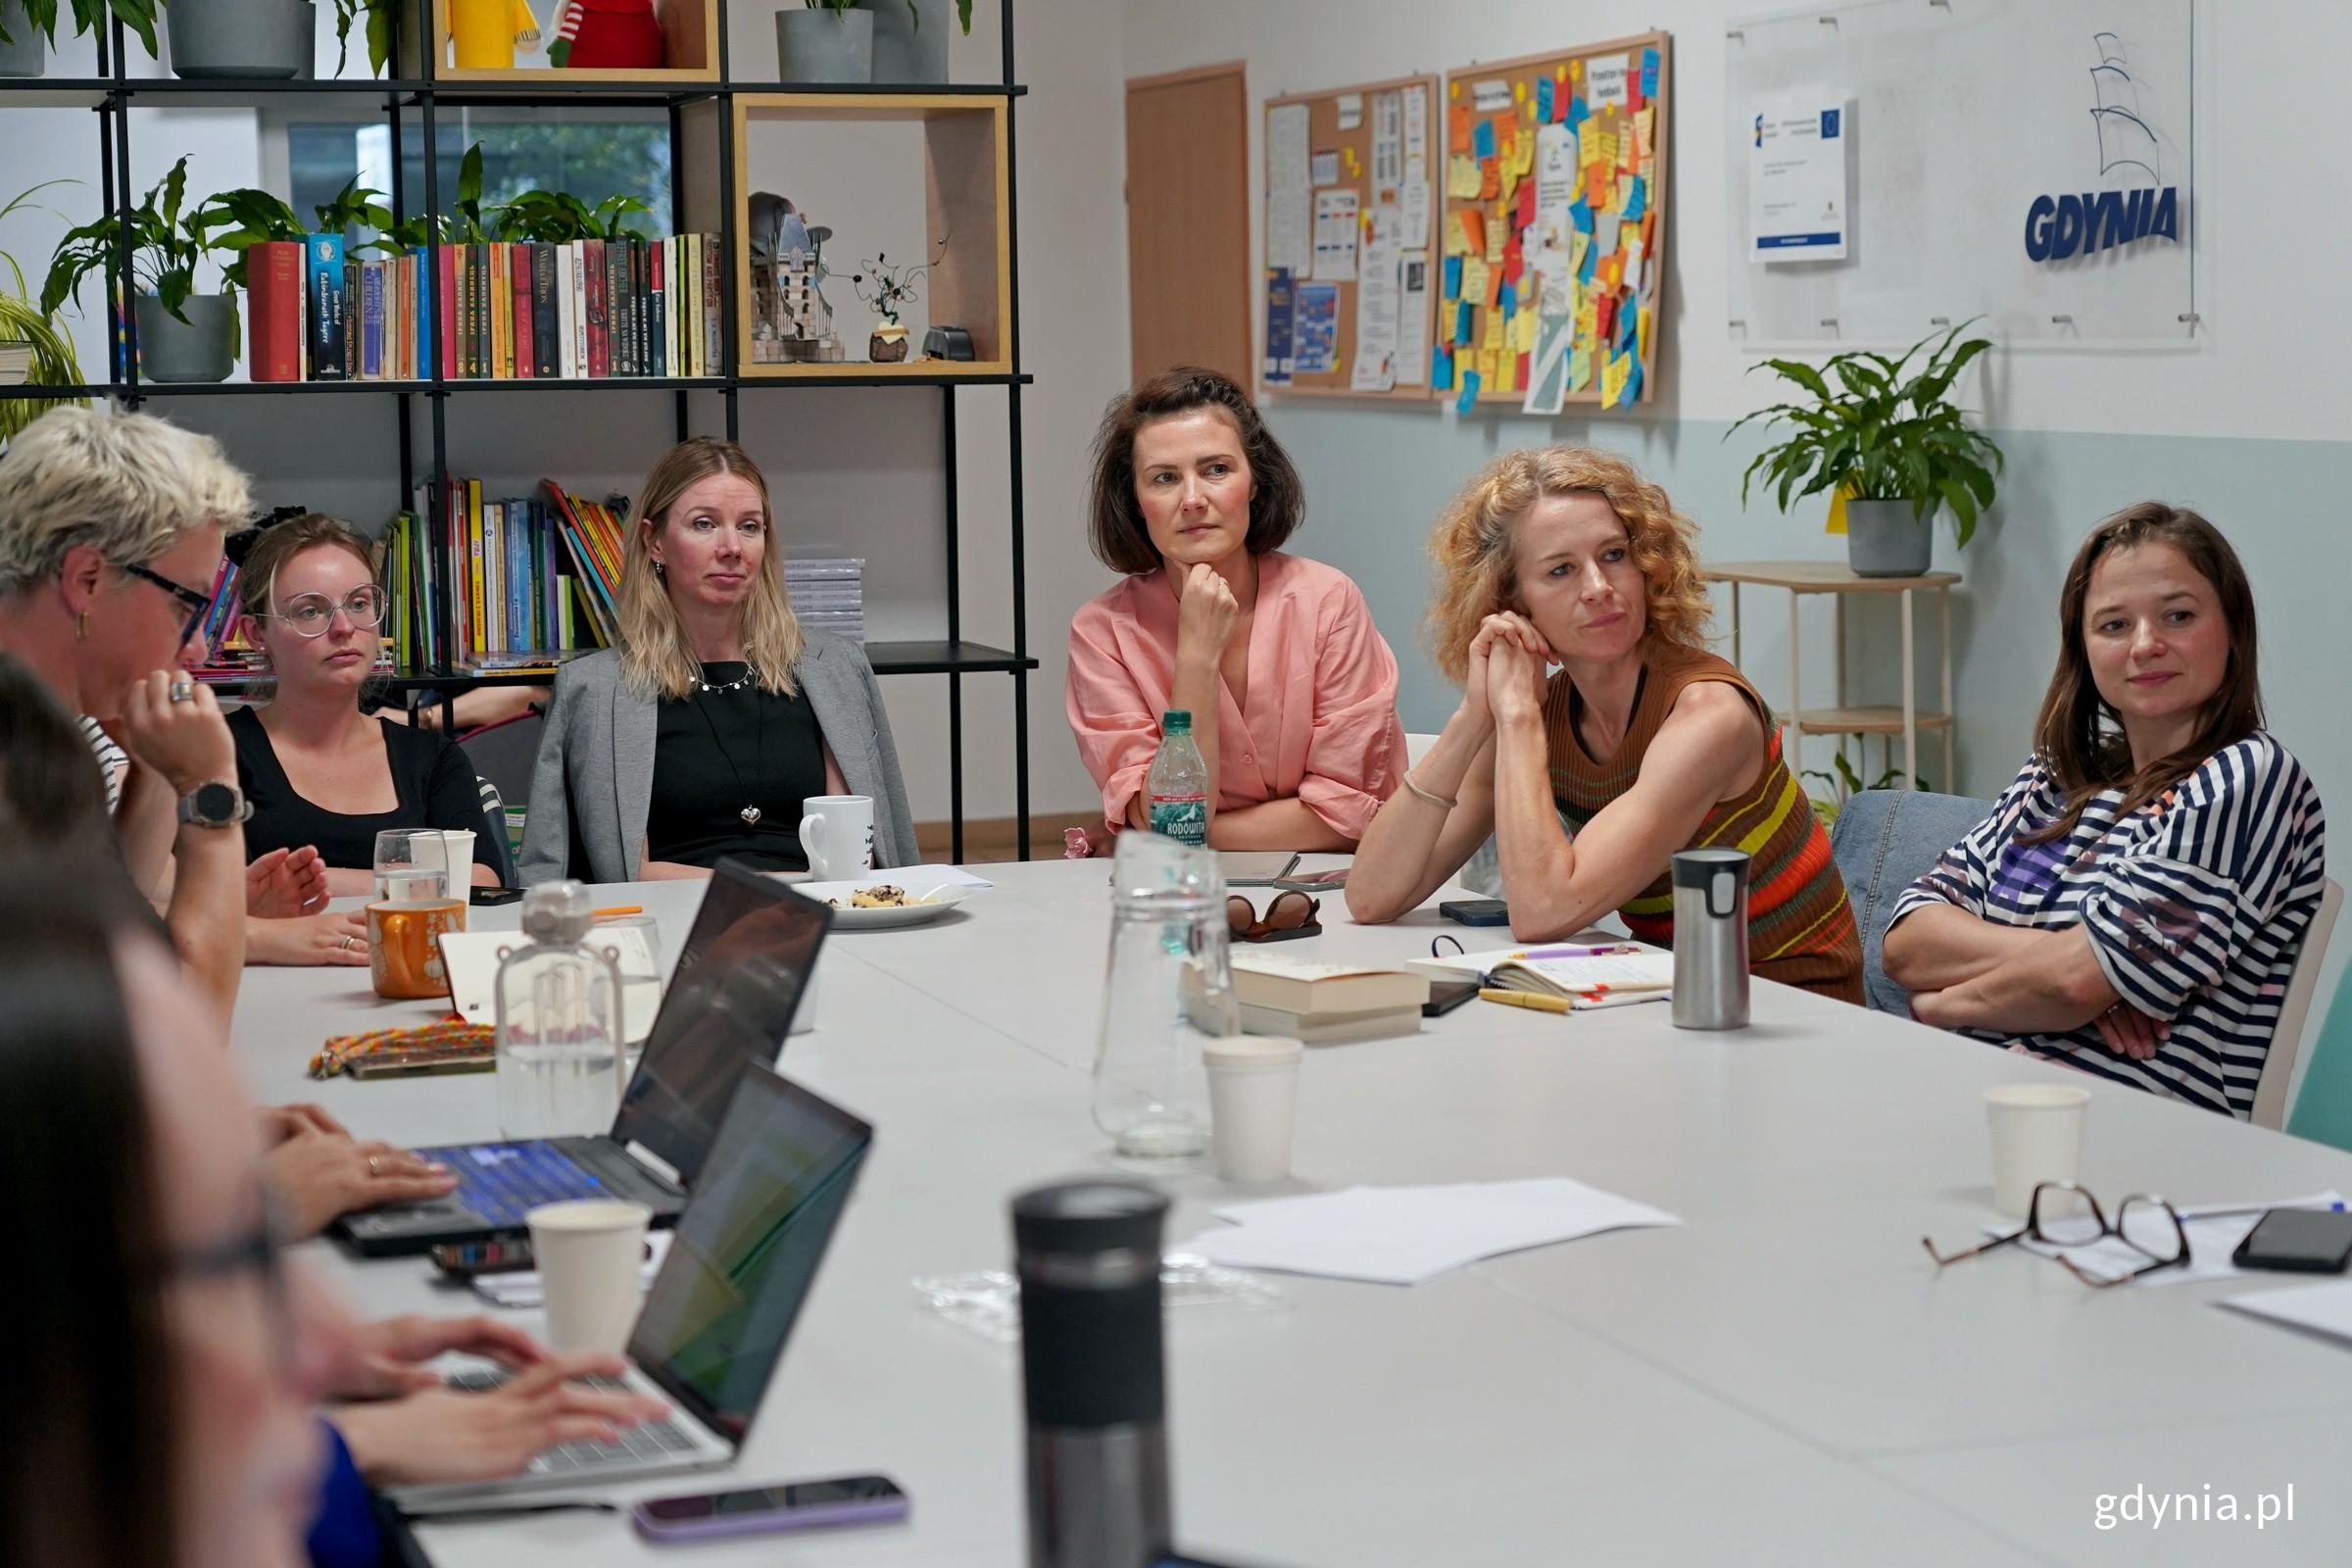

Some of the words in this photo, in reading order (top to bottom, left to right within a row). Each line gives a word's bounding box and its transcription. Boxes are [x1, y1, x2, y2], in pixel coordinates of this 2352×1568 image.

[2025, 186, 2177, 262] GDYNIA
[617, 240, 627, 267] JEFFREY
[320, 271, 329, 318] Rabindranath
[365, 275, 373, 314] CHILDREN
[540, 281, 549, 304] TRON
[320, 319, 330, 343] Tagore
[458, 362, 464, 373] 8
[469, 362, 476, 373] 4
[482, 362, 488, 373] 1
[1167, 822, 1205, 835] RODOWITA
